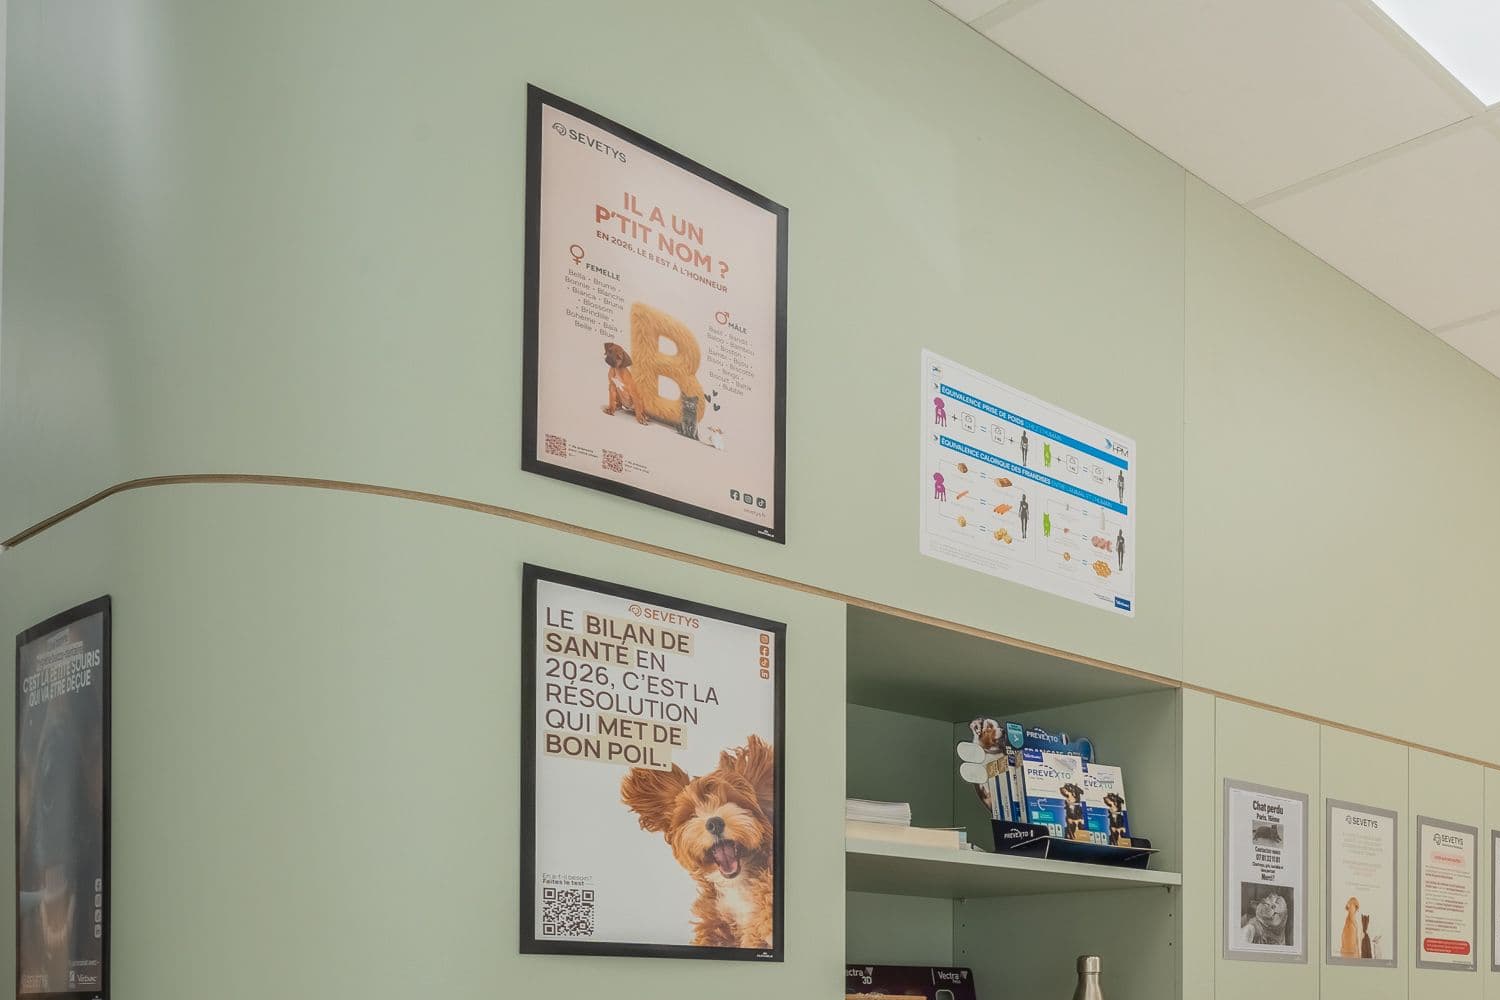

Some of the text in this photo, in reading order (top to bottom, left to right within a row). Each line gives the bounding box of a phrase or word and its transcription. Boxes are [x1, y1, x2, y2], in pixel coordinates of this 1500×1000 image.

[569, 128, 626, 163] SEVETYS
[624, 191, 704, 245] IL A UN
[595, 204, 729, 279] P'TIT NOM ?
[586, 263, 621, 281] FEMELLE
[596, 230, 609, 241] EN
[611, 236, 636, 254] 2026,
[637, 249, 647, 260] LE
[655, 255, 670, 268] EST
[680, 267, 728, 293] L'HONNEUR
[643, 606, 700, 629] SEVETYS
[545, 607, 690, 654] LE BILAN DE
[71, 649, 101, 674] SOURIS
[545, 633, 665, 672] SANTÉ EN
[545, 658, 720, 706] 2026, C'EST LA
[545, 679, 699, 725] RÉSOLUTION
[545, 708, 682, 747] QUI MET DE
[1026, 730, 1060, 744] PREVEXTO
[545, 734, 668, 768] BON POIL.
[1027, 768, 1071, 780] PREVEXTO
[1084, 779, 1113, 790] EVEXTO
[1252, 800, 1284, 815] Chat perdu
[1352, 816, 1379, 829] SEVETYS
[1441, 833, 1464, 846] SEVETYS
[862, 976, 873, 985] 3D
[938, 971, 959, 980] Vectra
